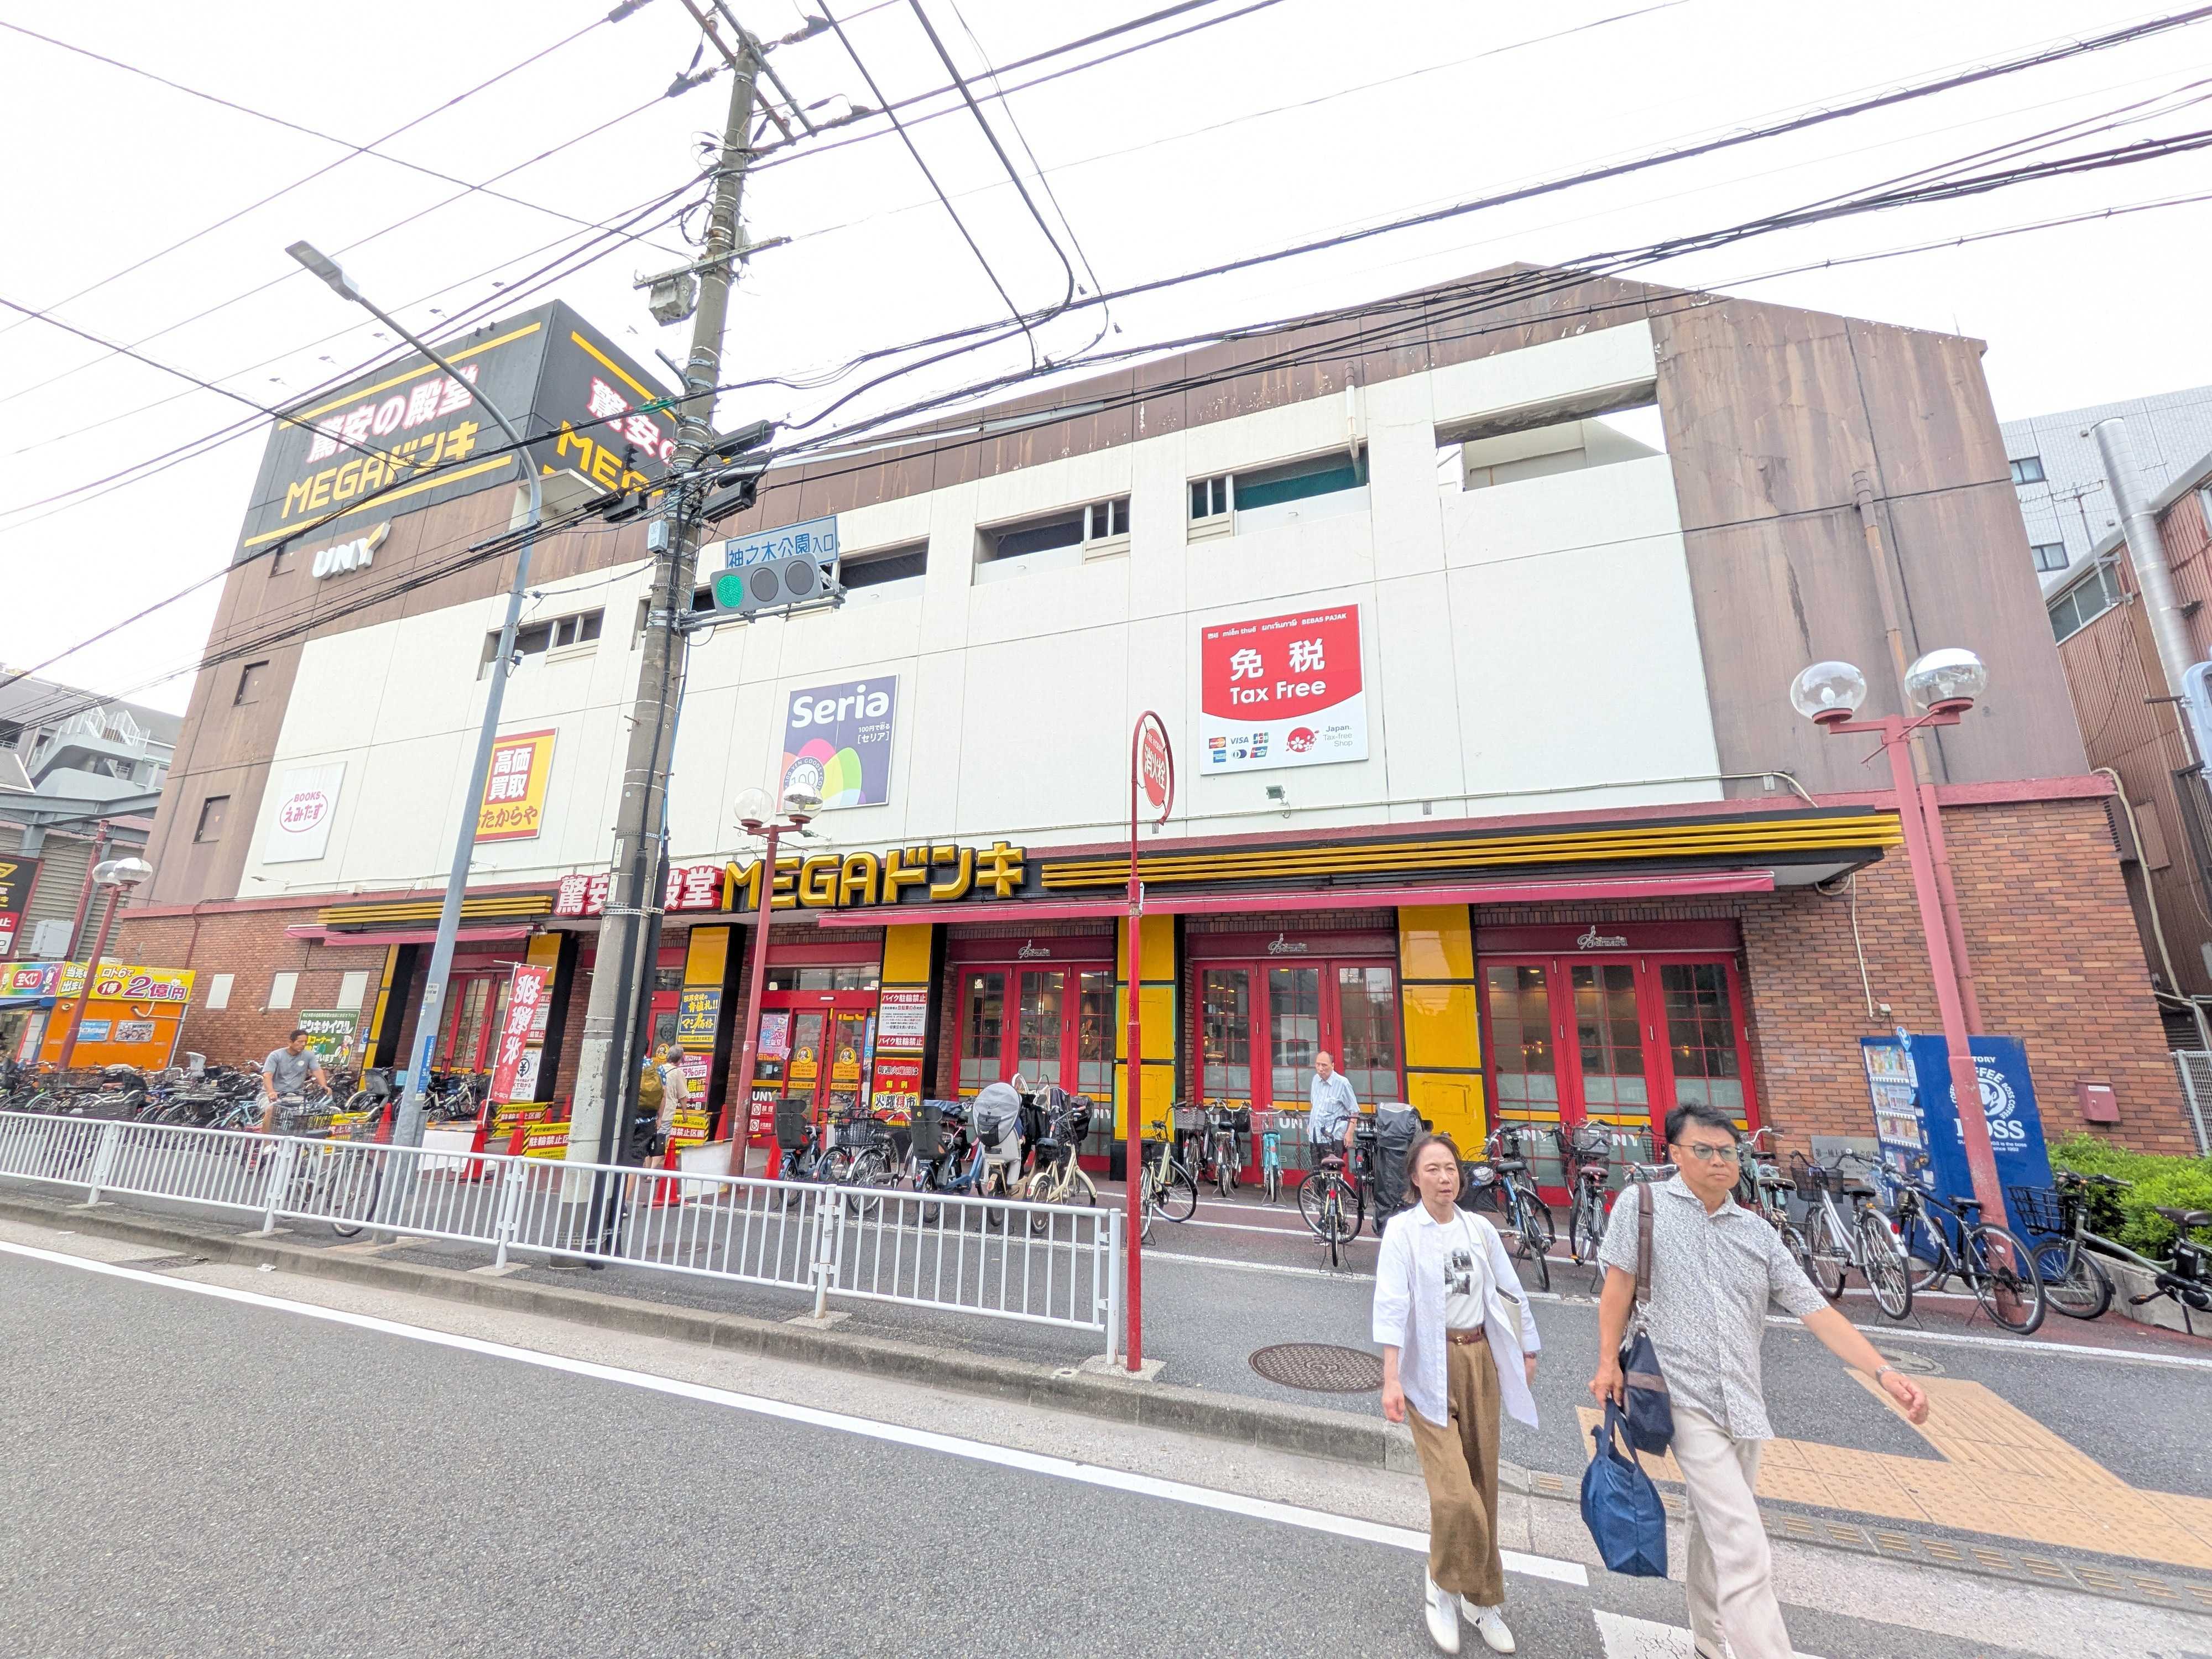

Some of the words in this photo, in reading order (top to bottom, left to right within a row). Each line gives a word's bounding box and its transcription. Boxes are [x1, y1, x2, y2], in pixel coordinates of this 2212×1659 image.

[307, 364, 478, 463] 驚安の殿堂
[281, 421, 479, 519] MEGAドンキ
[312, 522, 392, 579] UNY
[1302, 617, 1324, 625] BEBAS
[1325, 613, 1347, 622] PAJAK
[1230, 686, 1269, 705] Tax
[1276, 680, 1327, 700] Free
[791, 684, 889, 728] Seria
[1253, 732, 1269, 744] JCB
[1323, 733, 1353, 741] Tax-free
[1334, 739, 1353, 748] Shop
[493, 747, 533, 775] 高価
[791, 760, 802, 770] YEN
[804, 758, 822, 771] GOODS
[1144, 743, 1166, 789] 消火栓
[488, 774, 528, 801] 買取
[294, 791, 321, 802] BOOKS
[284, 803, 324, 823] えみたす
[16, 972, 38, 986] 宝くじ
[101, 967, 135, 979] ロト6で
[101, 983, 118, 994] 1等
[122, 974, 187, 1000] 2億円
[882, 994, 926, 1003] バイク駐輪禁止
[299, 1020, 354, 1035] ドンキサイクル
[878, 1037, 923, 1046] バイク駐輪禁止
[682, 1067, 706, 1077] 5%OFF
[878, 1065, 919, 1076] 毎週火曜日は
[1975, 1066, 2005, 1083] FEE
[752, 1090, 775, 1102] UNY
[875, 1093, 918, 1109] 火曜得市
[1999, 1100, 2016, 1119] COFFEE
